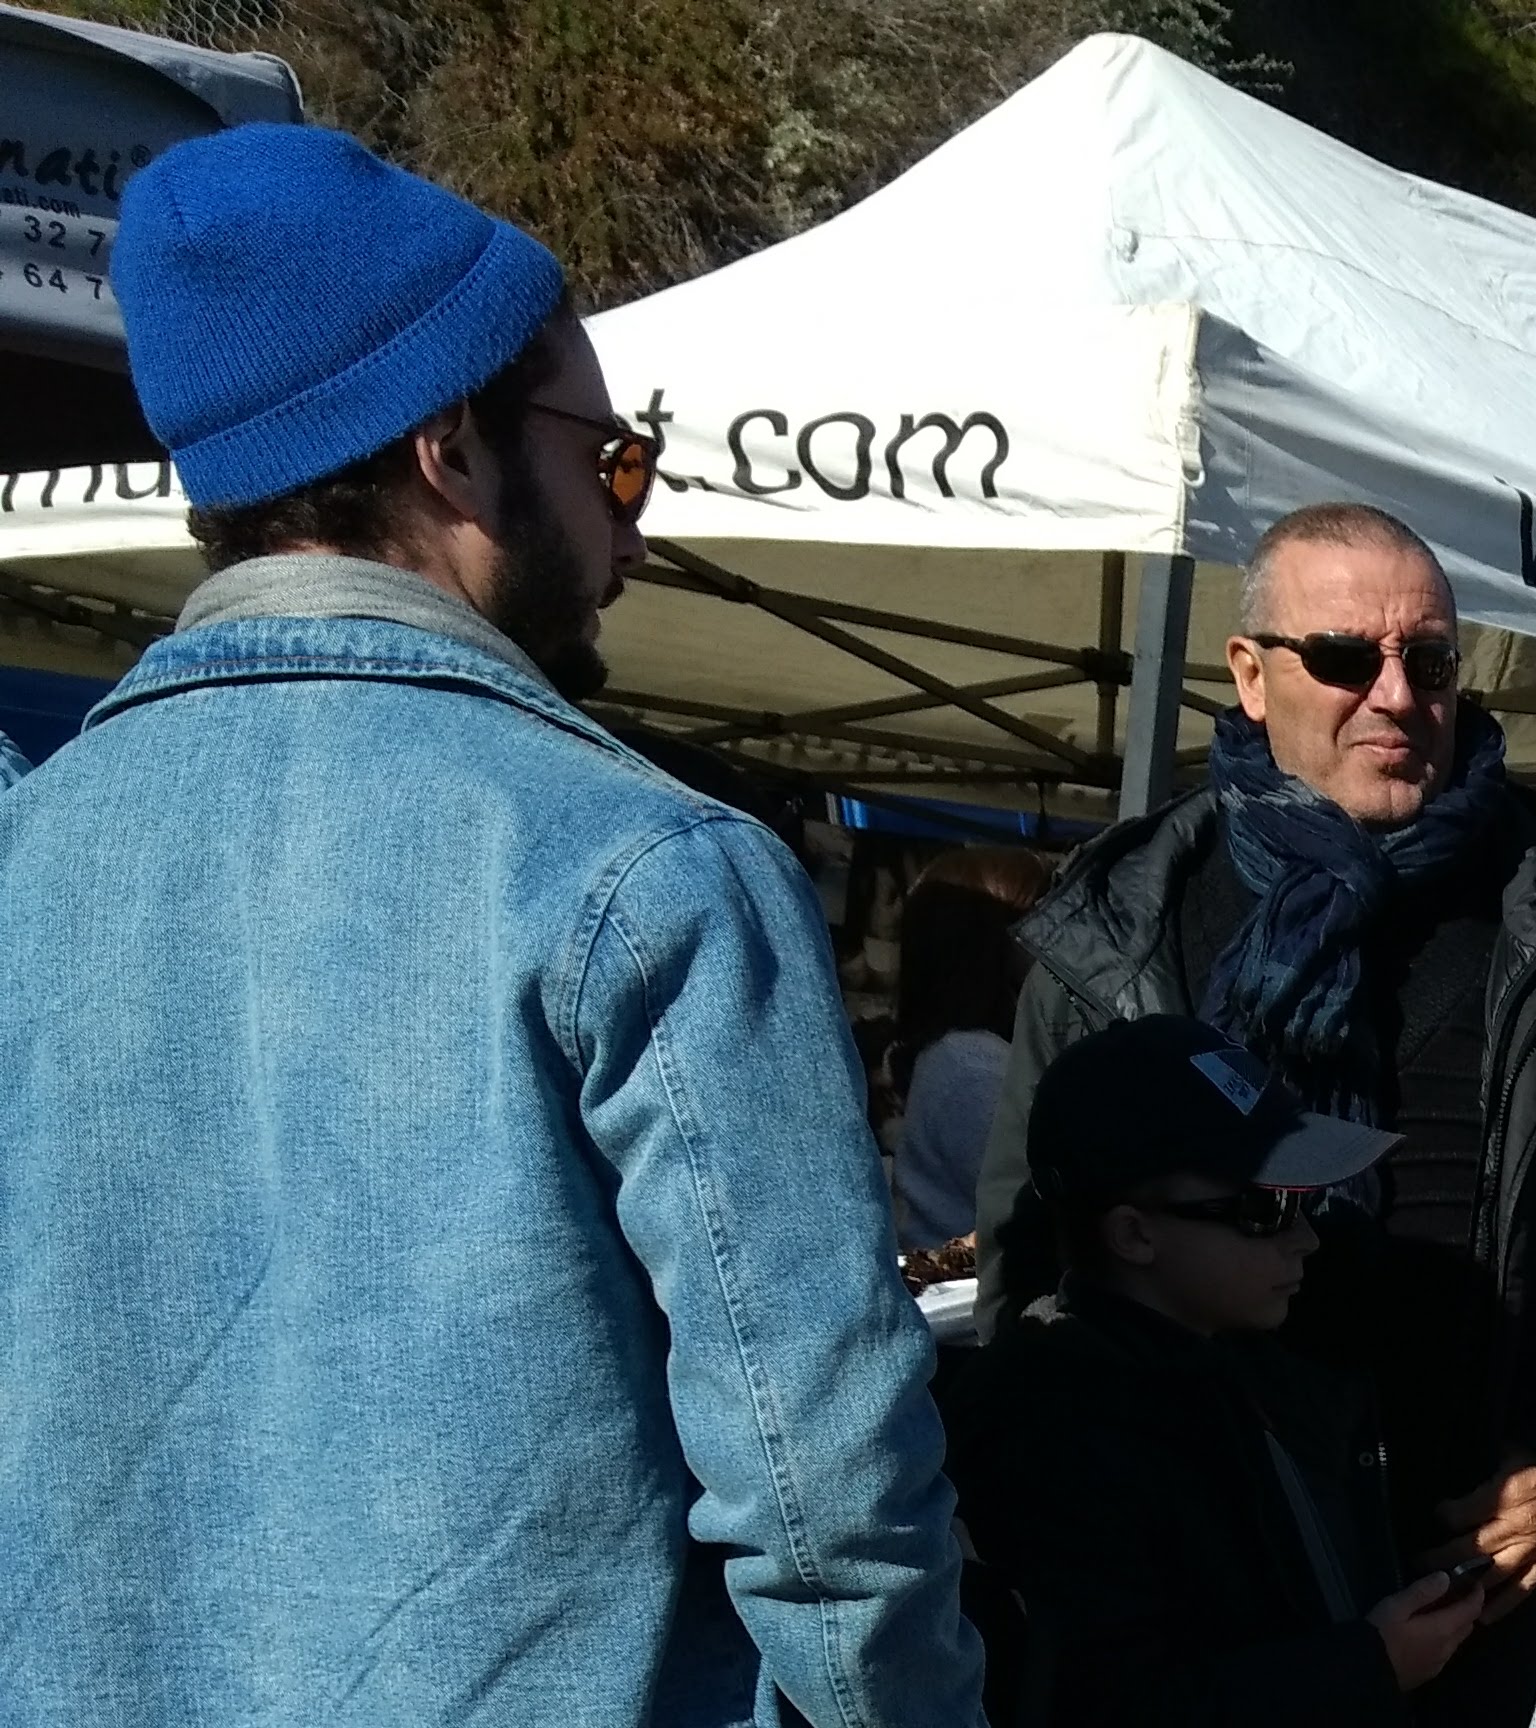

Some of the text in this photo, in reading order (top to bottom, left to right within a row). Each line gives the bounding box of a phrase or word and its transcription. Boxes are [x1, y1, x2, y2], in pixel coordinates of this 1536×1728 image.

[24, 214, 67, 249] 32
[23, 262, 68, 293] 64
[614, 388, 1010, 501] t.com
